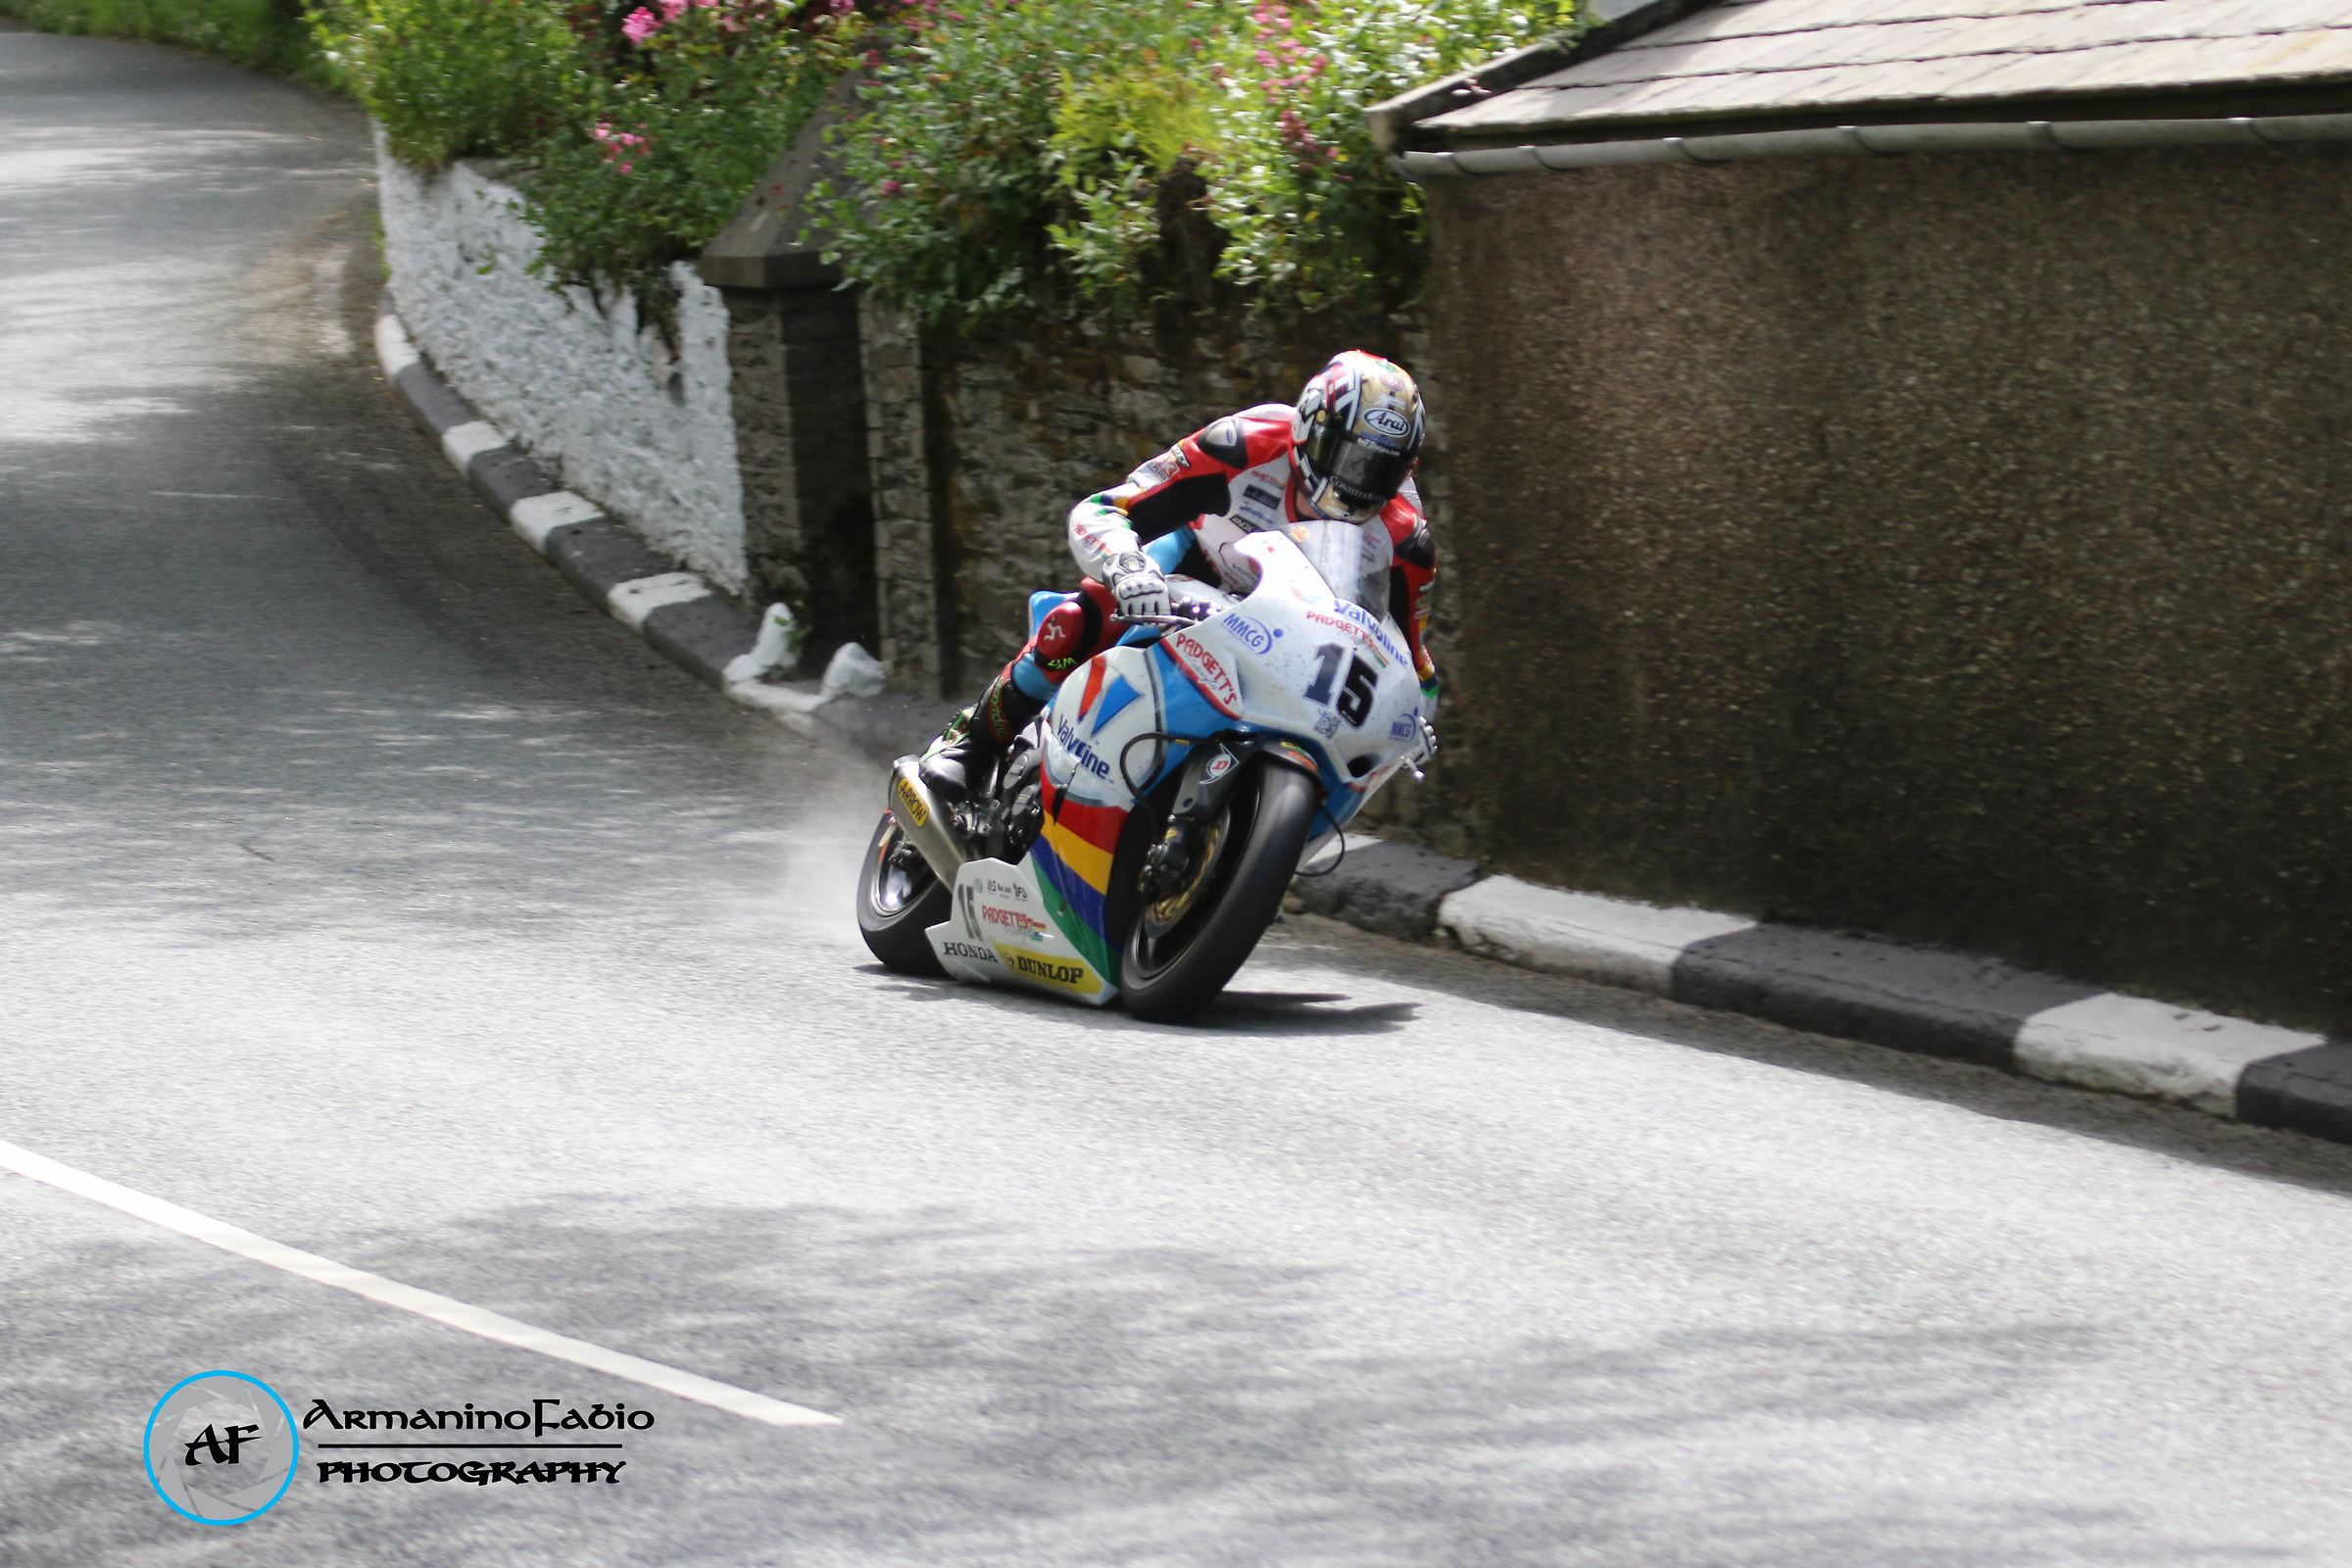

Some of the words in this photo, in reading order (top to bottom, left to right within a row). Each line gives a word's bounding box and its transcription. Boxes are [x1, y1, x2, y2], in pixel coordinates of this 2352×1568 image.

[1369, 412, 1407, 432] Arai
[1223, 613, 1264, 647] MMCG
[1334, 599, 1409, 667] Valvoline
[1176, 633, 1237, 705] PADGETT'S
[1304, 641, 1380, 728] 15
[1057, 713, 1111, 779] Valvoine
[899, 781, 928, 821] ARROW
[943, 942, 999, 963] HONDA
[1016, 955, 1084, 985] DUNLOP
